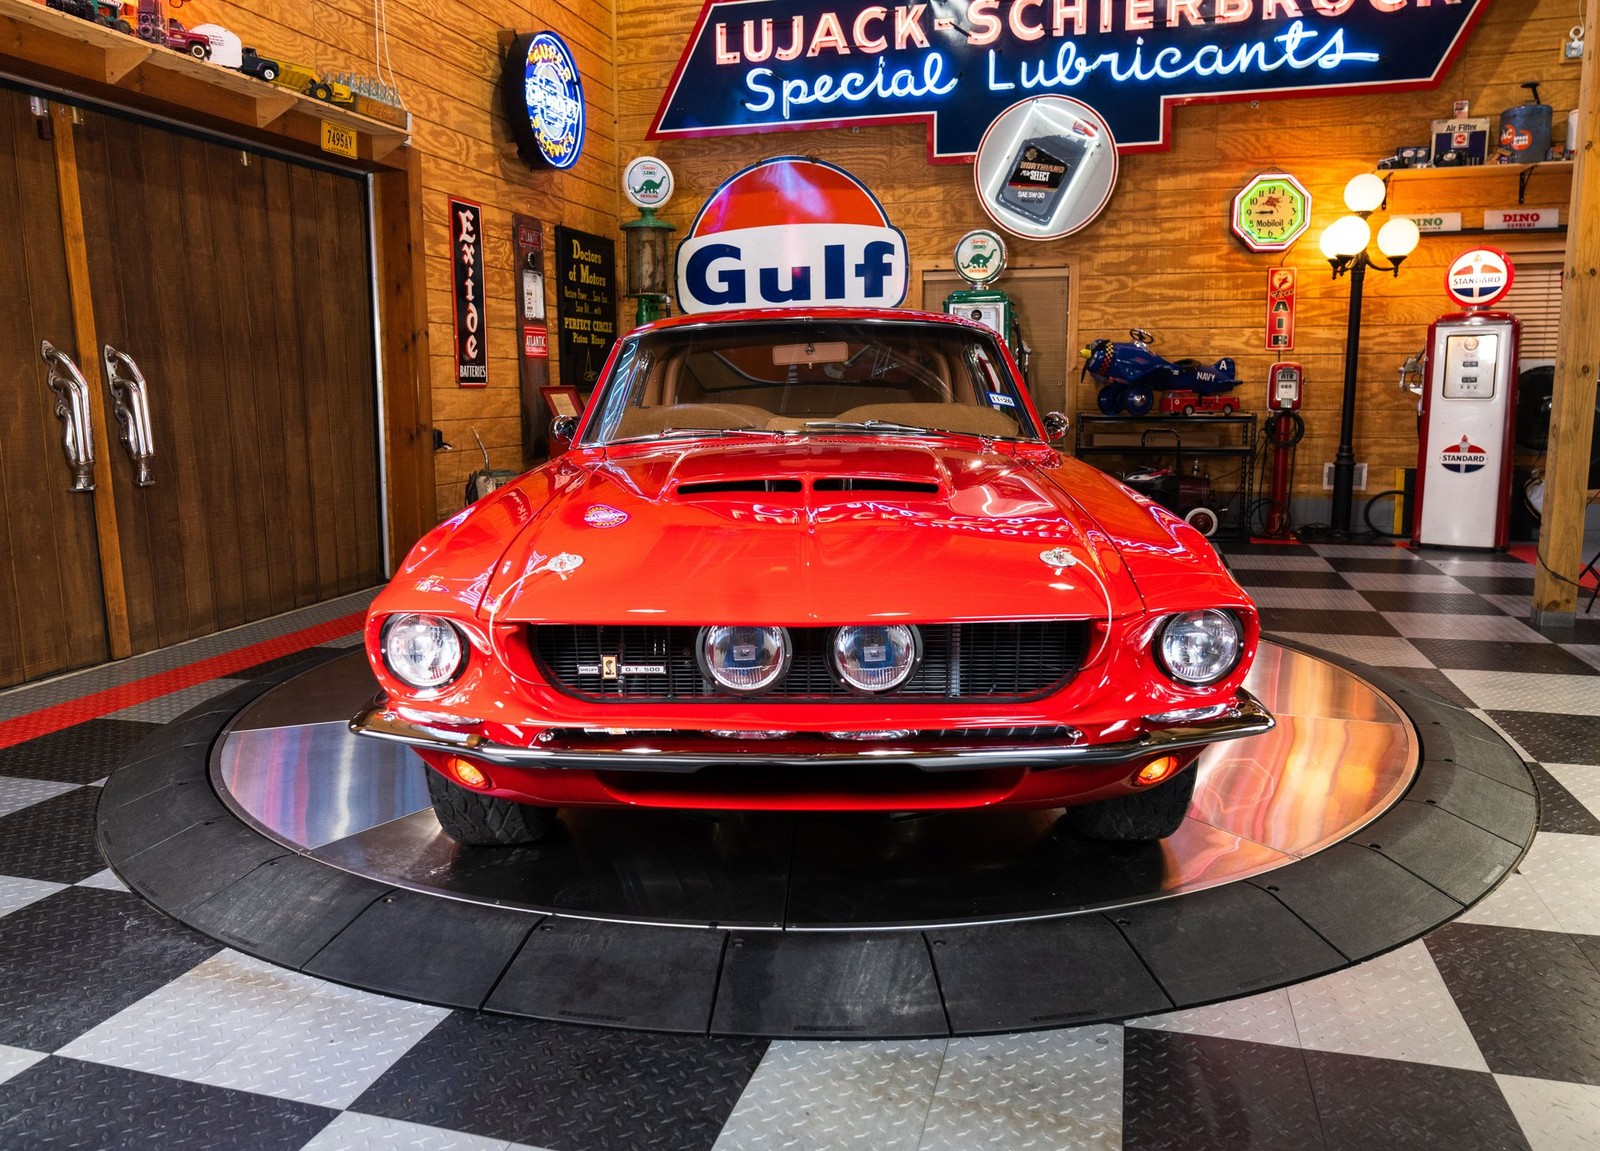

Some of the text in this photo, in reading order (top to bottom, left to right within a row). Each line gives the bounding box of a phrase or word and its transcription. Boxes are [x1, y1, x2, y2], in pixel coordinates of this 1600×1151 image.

[743, 20, 1380, 119] Special Lubricants
[1458, 123, 1478, 131] Filter
[327, 130, 353, 149] 7495AV
[1020, 161, 1065, 174] NORTHLAND
[1029, 170, 1050, 182] SELECT
[1017, 190, 1029, 198] SAE
[1268, 187, 1276, 195] 12
[1256, 219, 1284, 228] Mobiloil
[1502, 213, 1540, 223] DINO
[572, 239, 602, 264] Doctors
[568, 263, 606, 287] of Motors
[685, 240, 895, 306] Gulf
[458, 209, 478, 360] Exide
[1453, 276, 1501, 286] STANDARD
[564, 317, 613, 333] PERFECT CIRCLE
[1271, 300, 1290, 347] AIR
[525, 335, 546, 348] ATLANTIC
[572, 332, 606, 348] Piston Rings
[459, 364, 486, 379] BATTERIES
[1219, 360, 1228, 371] A
[1196, 371, 1216, 383] NAVY
[1442, 454, 1485, 463] STANDARD
